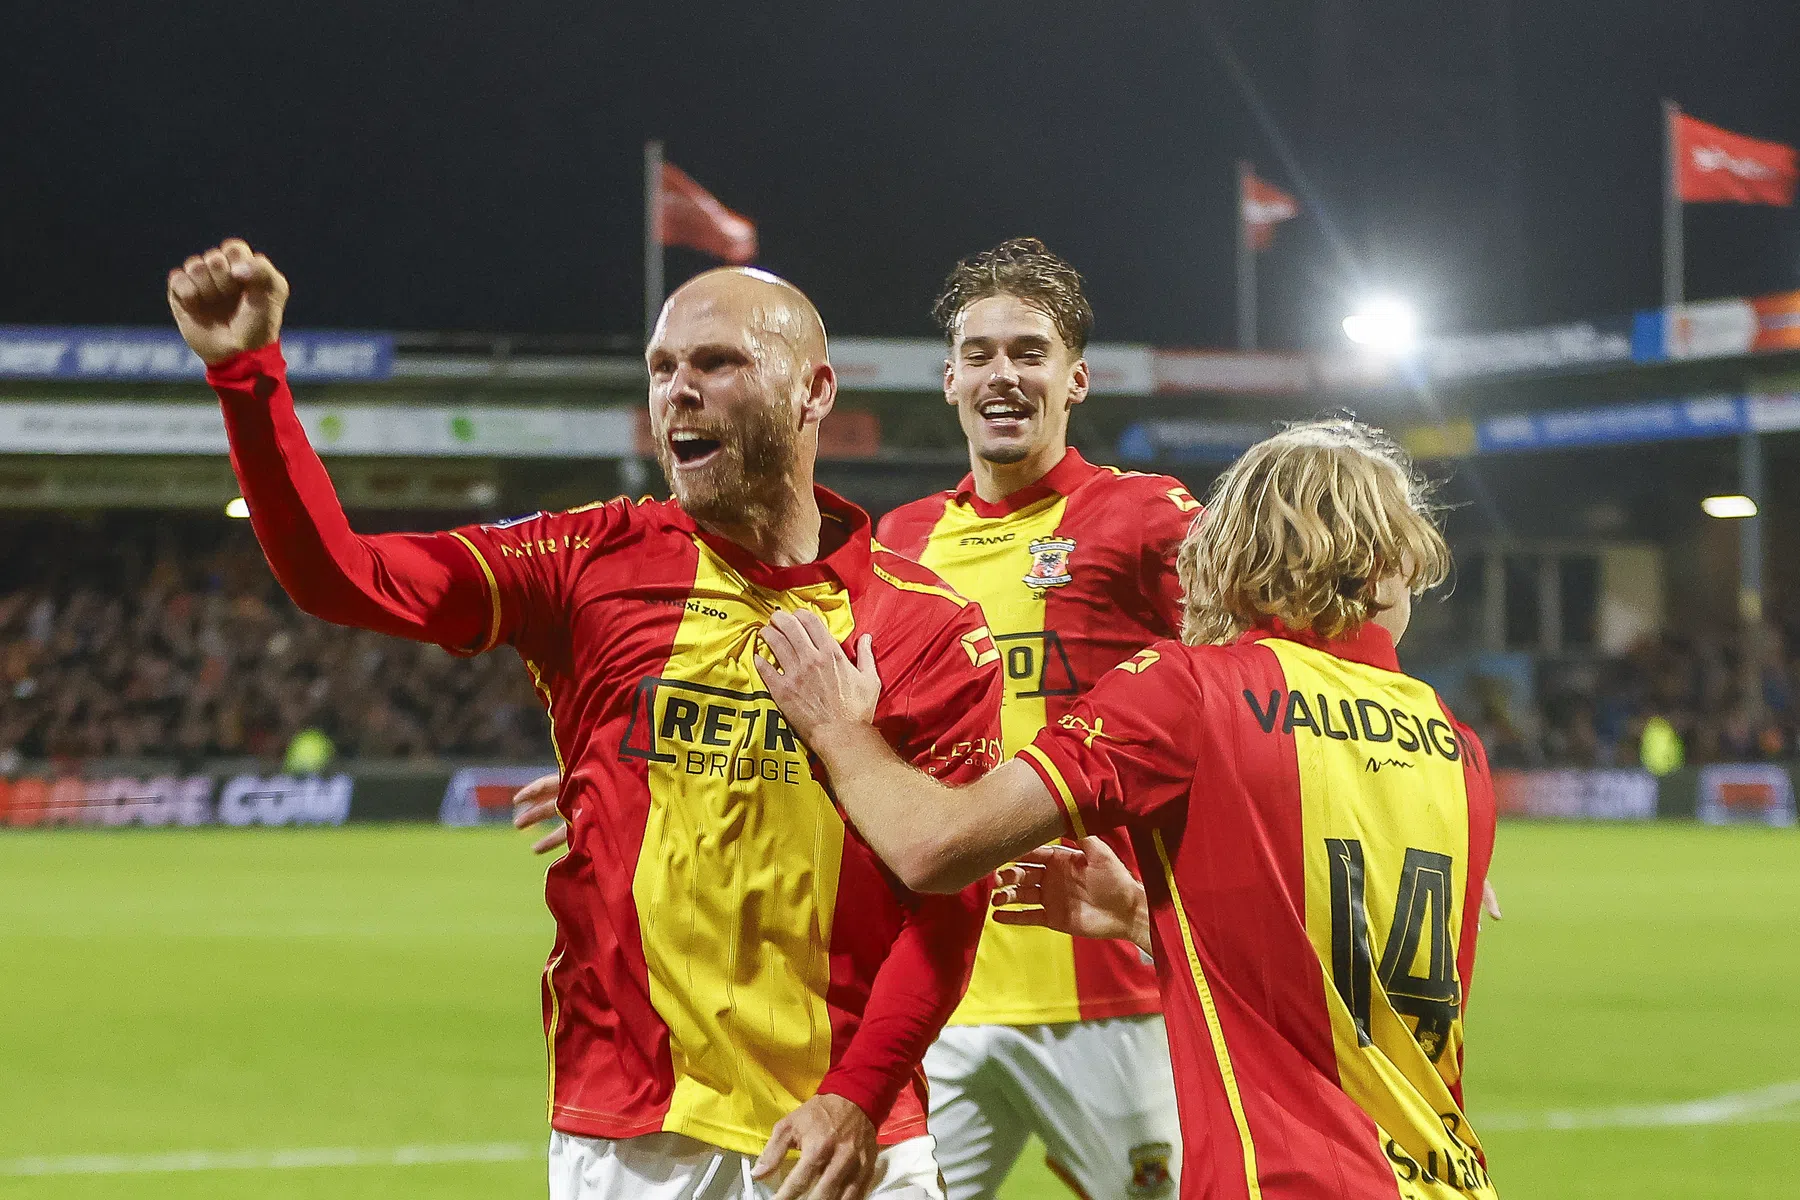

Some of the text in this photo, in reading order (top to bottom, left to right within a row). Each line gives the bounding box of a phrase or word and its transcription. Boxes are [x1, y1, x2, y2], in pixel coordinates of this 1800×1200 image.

[701, 606, 728, 620] zoo
[661, 697, 797, 752] RETR
[685, 751, 800, 785] BRDGE
[1324, 838, 1462, 1063] 14
